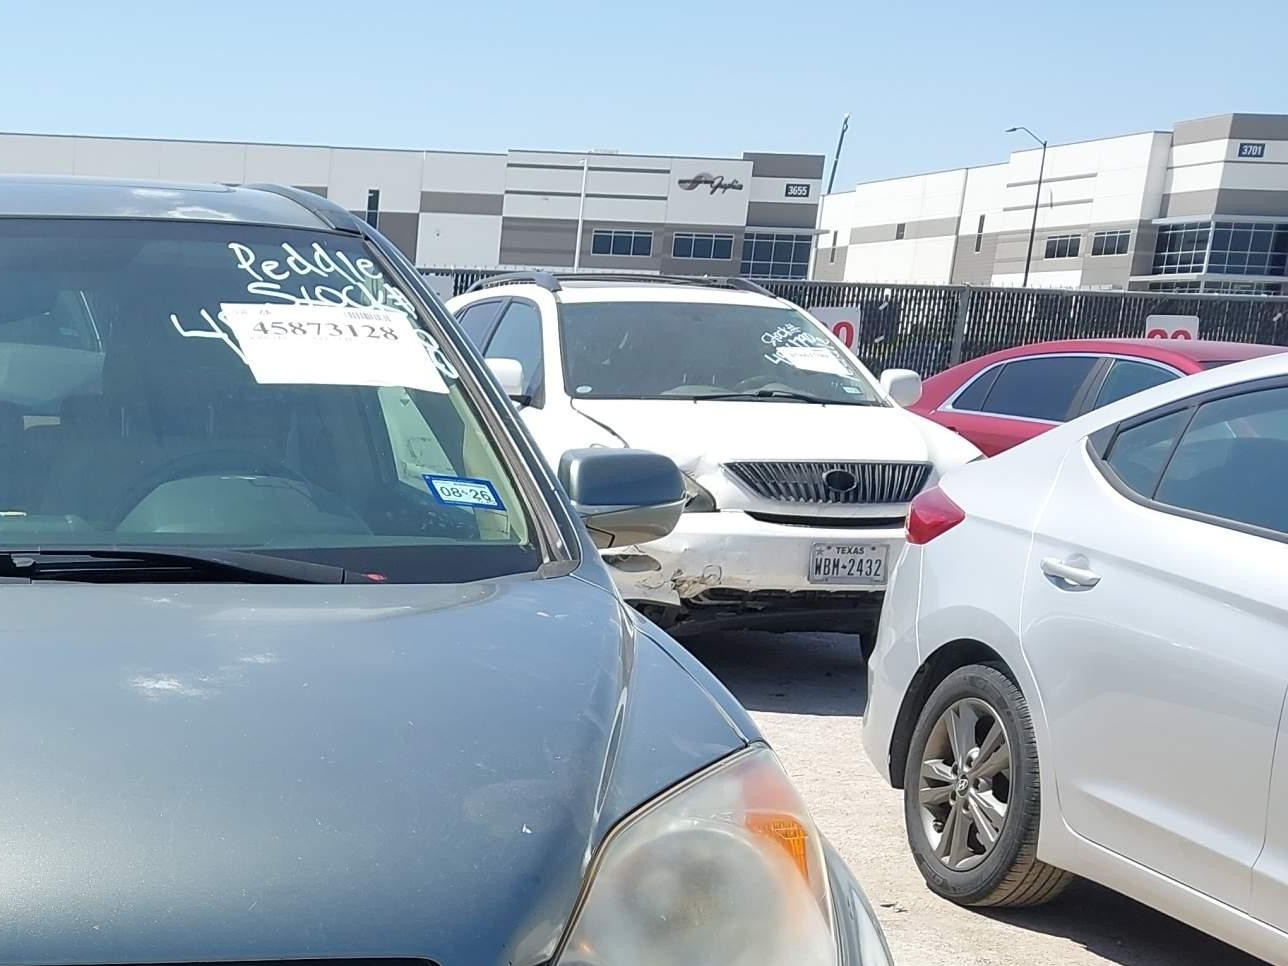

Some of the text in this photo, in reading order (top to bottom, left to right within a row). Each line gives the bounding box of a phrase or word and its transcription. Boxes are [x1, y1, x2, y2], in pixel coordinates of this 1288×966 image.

[1241, 145, 1263, 156] 3701
[787, 185, 808, 196] 3655
[228, 242, 384, 285] Peddle
[252, 320, 400, 342] 45873128
[836, 546, 865, 555] TEXAS
